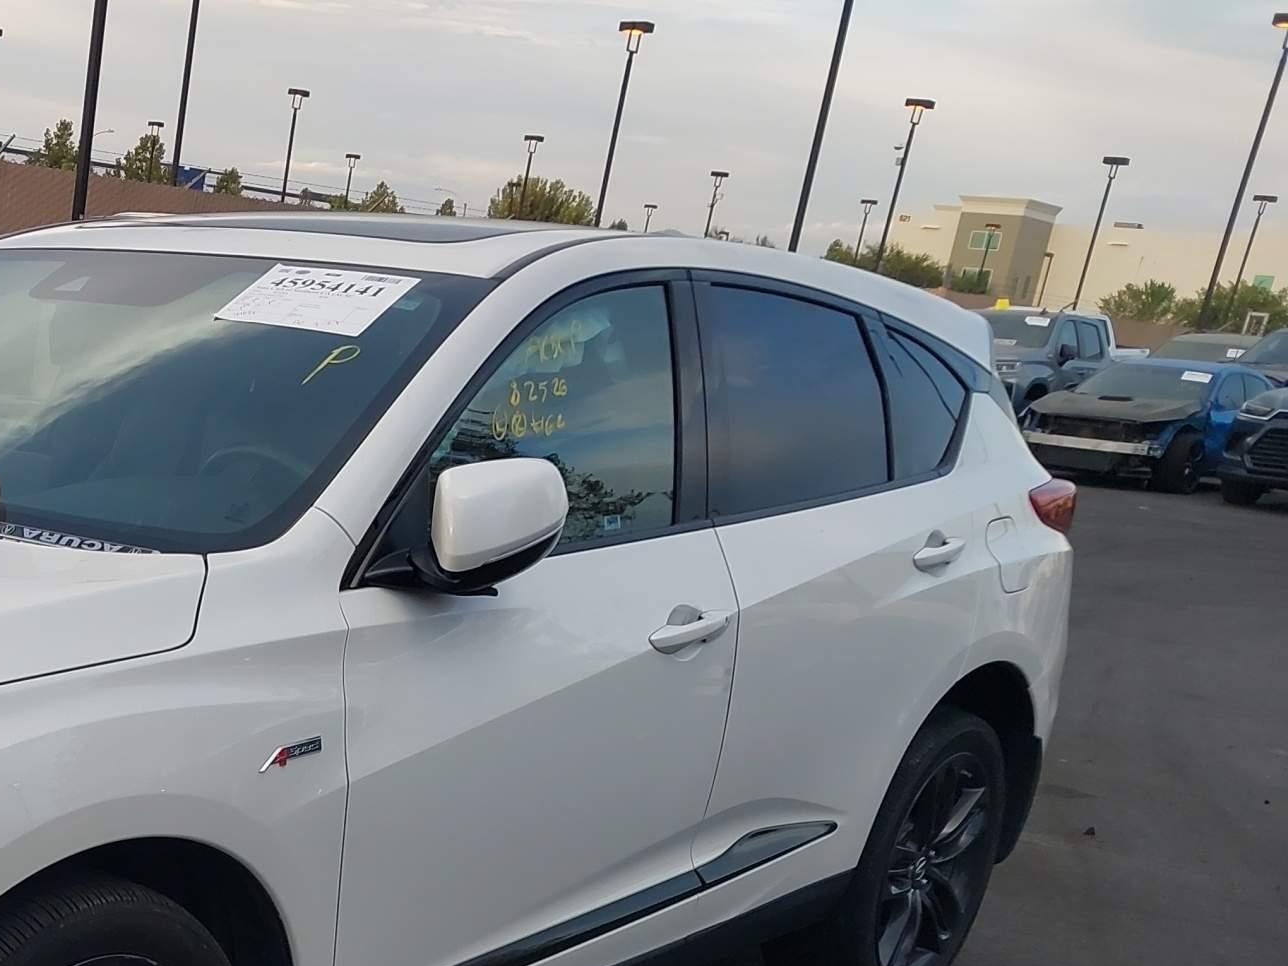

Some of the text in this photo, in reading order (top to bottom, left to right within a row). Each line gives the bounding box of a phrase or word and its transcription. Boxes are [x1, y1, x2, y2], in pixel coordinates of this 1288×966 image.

[270, 276, 387, 297] 45954141
[301, 345, 361, 385] P
[23, 527, 123, 553] ACURA
